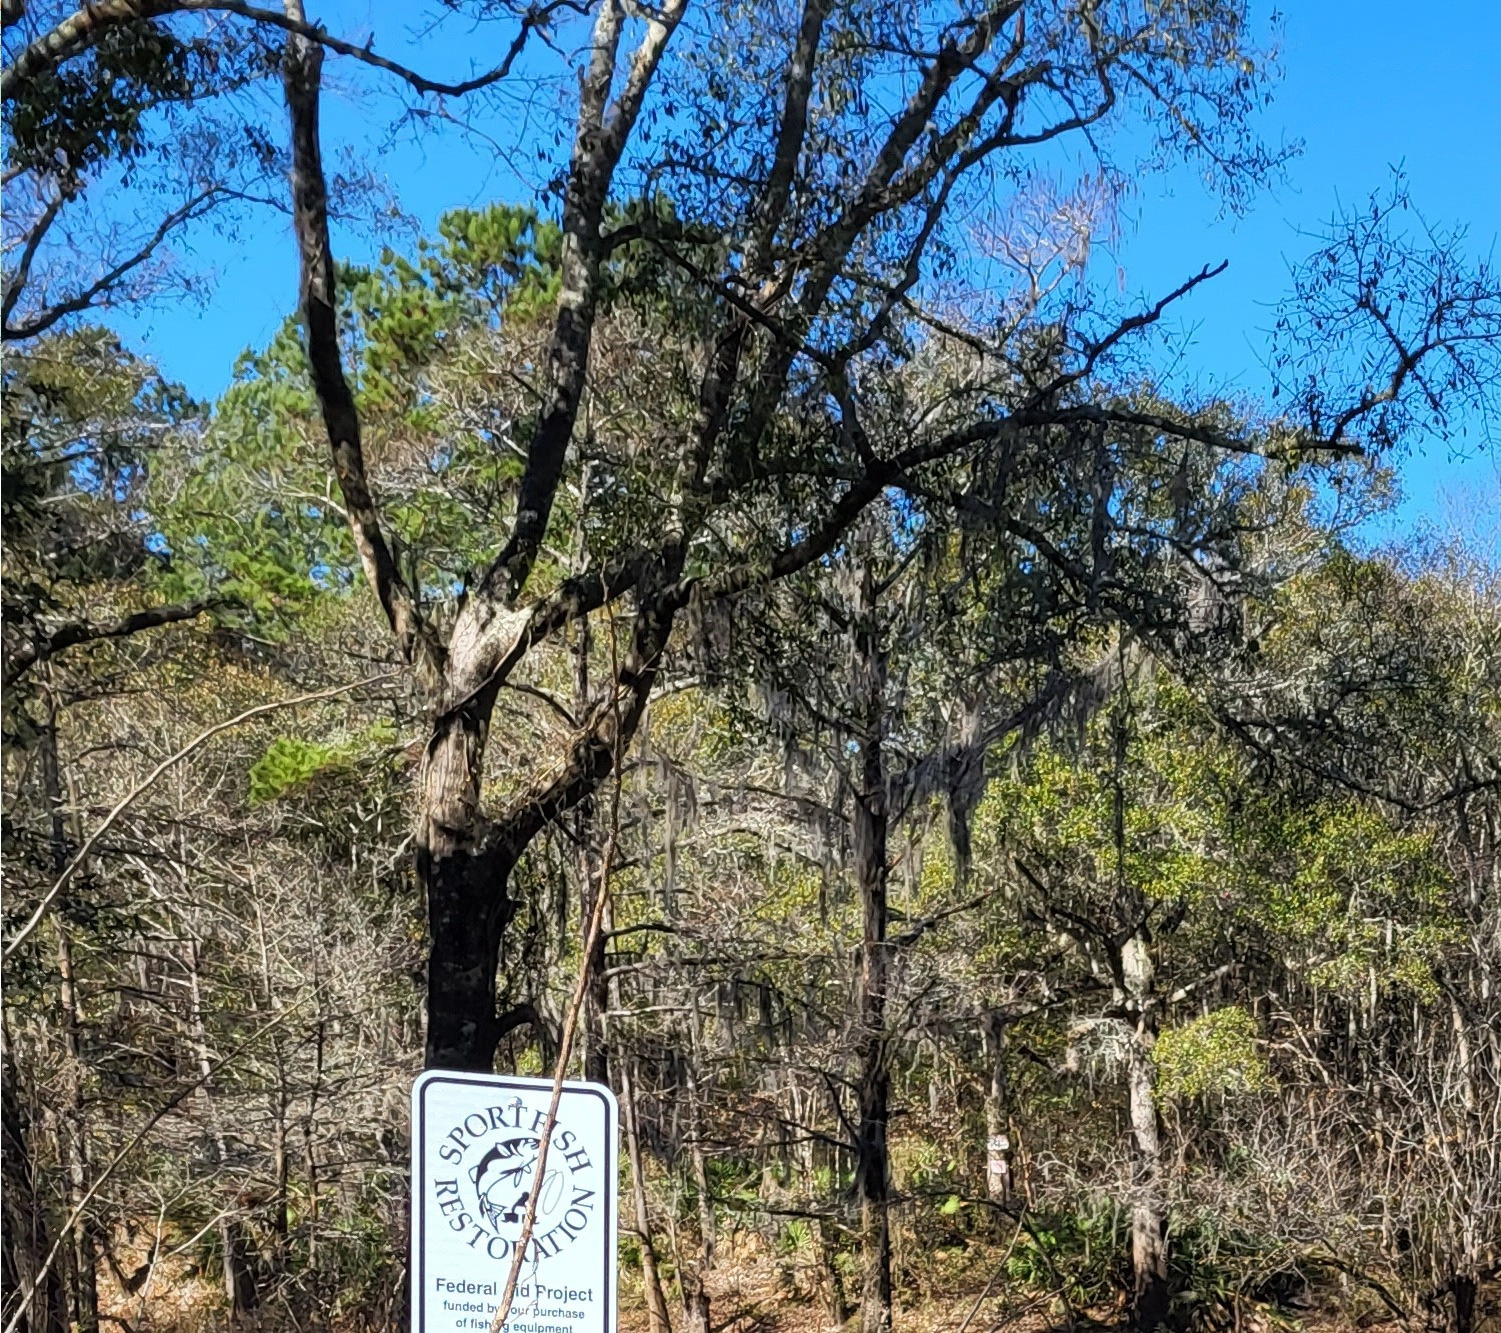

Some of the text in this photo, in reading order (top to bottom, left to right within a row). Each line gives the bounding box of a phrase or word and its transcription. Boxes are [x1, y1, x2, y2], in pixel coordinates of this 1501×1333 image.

[439, 1104, 528, 1166] SPORT
[436, 1278, 593, 1304] Federal id Project
[443, 1300, 484, 1313] funded
[533, 1307, 585, 1319] purchase
[456, 1318, 467, 1328] of
[470, 1319, 510, 1333] fishg
